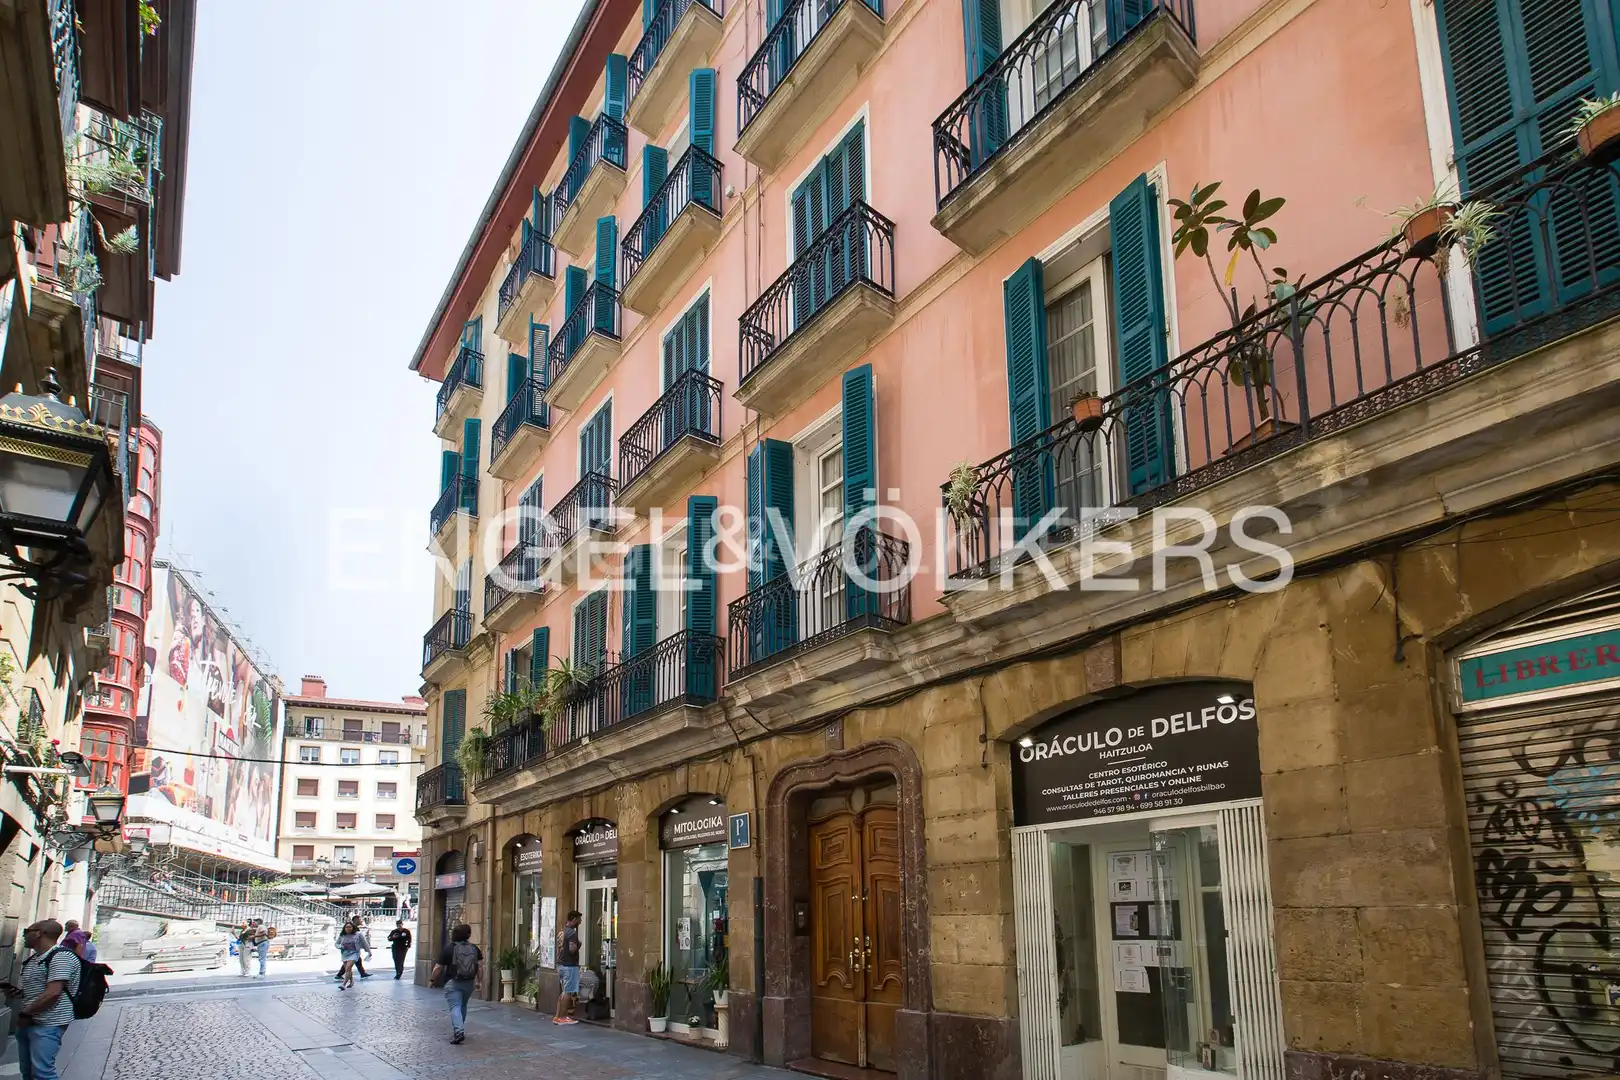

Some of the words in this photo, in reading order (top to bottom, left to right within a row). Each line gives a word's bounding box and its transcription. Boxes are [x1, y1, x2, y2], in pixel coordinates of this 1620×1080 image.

[1020, 727, 1123, 763] ORÁCULO
[1128, 726, 1145, 739] DE
[1151, 698, 1256, 738] DELFOS
[1099, 743, 1153, 759] HAITZULOA
[1041, 783, 1083, 796] CONSULTAS
[1085, 781, 1096, 789] DE
[1096, 777, 1124, 788] TAROT,
[1125, 767, 1187, 784] QUIROMANCIA
[1196, 760, 1229, 772] RUNAS
[1088, 769, 1120, 780] CENTRO
[1121, 760, 1168, 774] ESOTÉRICO
[1062, 789, 1098, 801] TALLERES
[1099, 781, 1159, 796] PRESENCIALES
[1168, 774, 1202, 786] ONLINE
[1151, 783, 1226, 799] oraculodelfosbilbao
[1094, 806, 1106, 815] 946
[1107, 805, 1115, 814] 57
[1116, 804, 1125, 812] 98
[1126, 803, 1135, 811] 94
[1140, 800, 1153, 809] 699
[1154, 799, 1163, 807] 58
[1164, 798, 1172, 806] 91
[1173, 797, 1183, 805] 30
[674, 816, 724, 835] MITOLOGIKA
[736, 818, 744, 837] P
